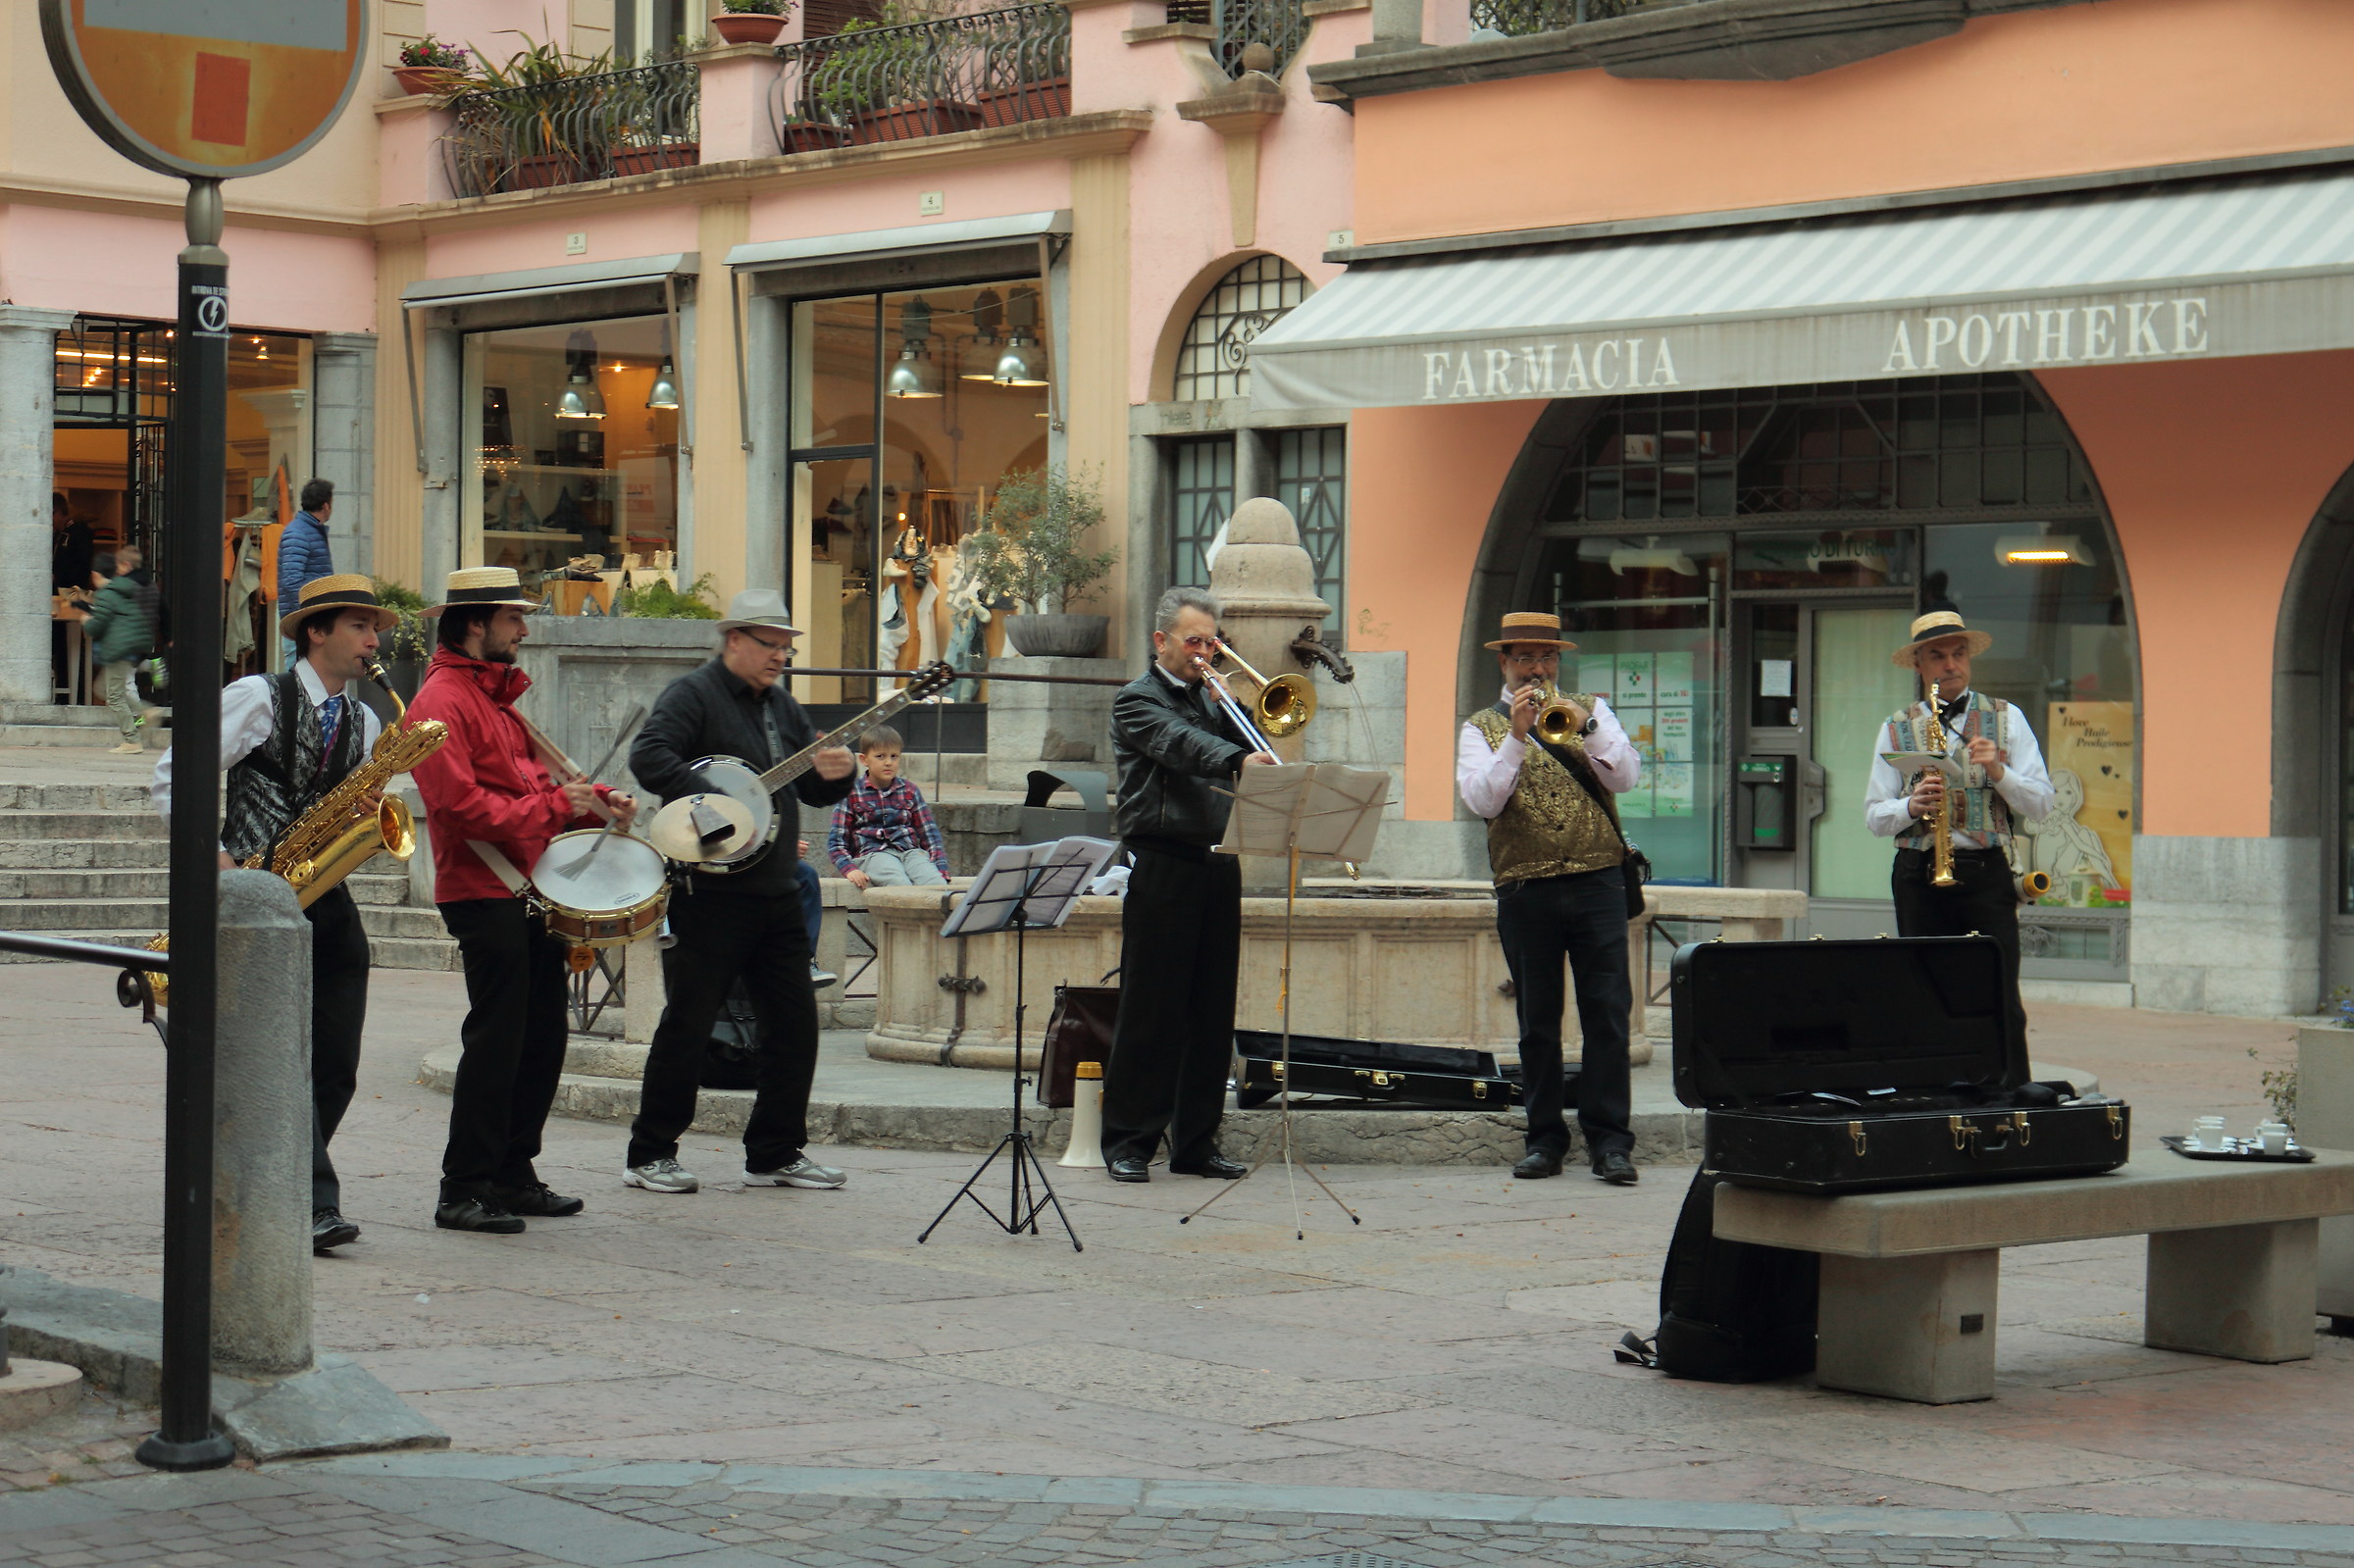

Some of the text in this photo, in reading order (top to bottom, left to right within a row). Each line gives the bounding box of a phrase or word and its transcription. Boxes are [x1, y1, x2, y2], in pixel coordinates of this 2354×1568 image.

[1338, 234, 1345, 244] 5
[1881, 297, 2208, 373] APOTHEKE
[1422, 337, 1680, 400] FARMACIA
